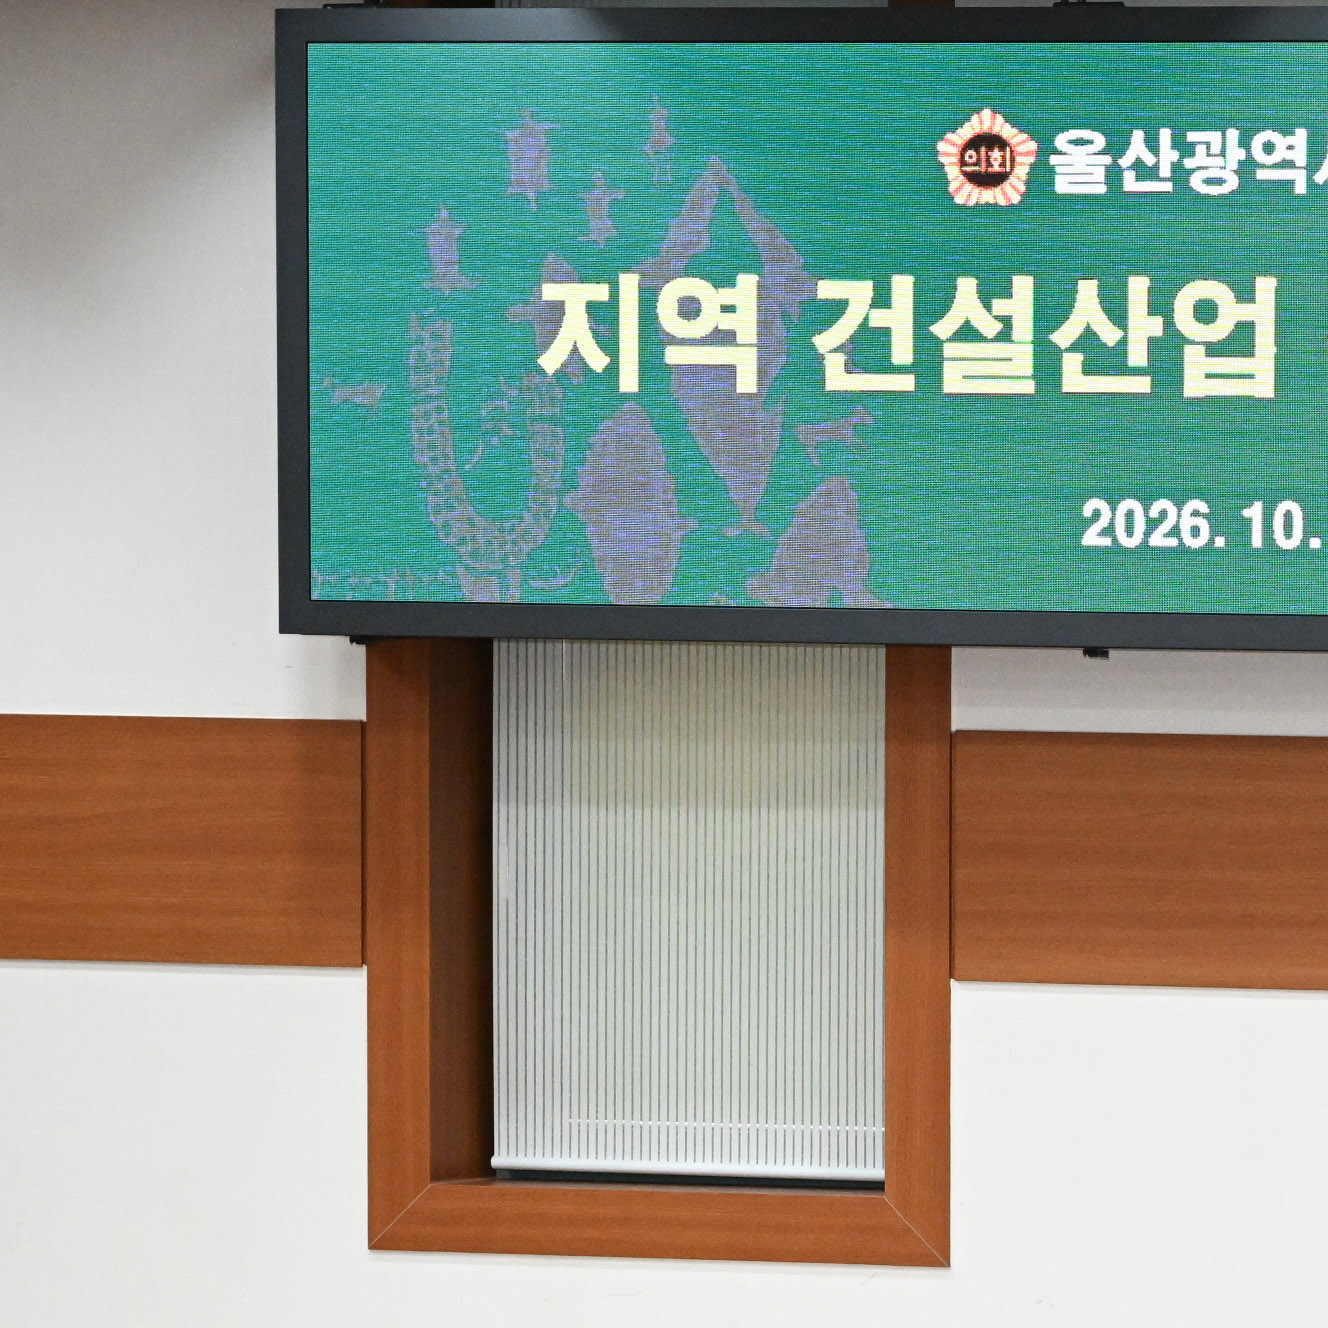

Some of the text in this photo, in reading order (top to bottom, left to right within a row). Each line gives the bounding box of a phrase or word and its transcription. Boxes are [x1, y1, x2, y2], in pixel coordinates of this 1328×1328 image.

[961, 145, 1012, 174] 의회
[537, 272, 760, 394] 지역
[812, 274, 1278, 398] 건설산업
[1081, 498, 1226, 549] 2026.
[1242, 500, 1321, 550] 10.
